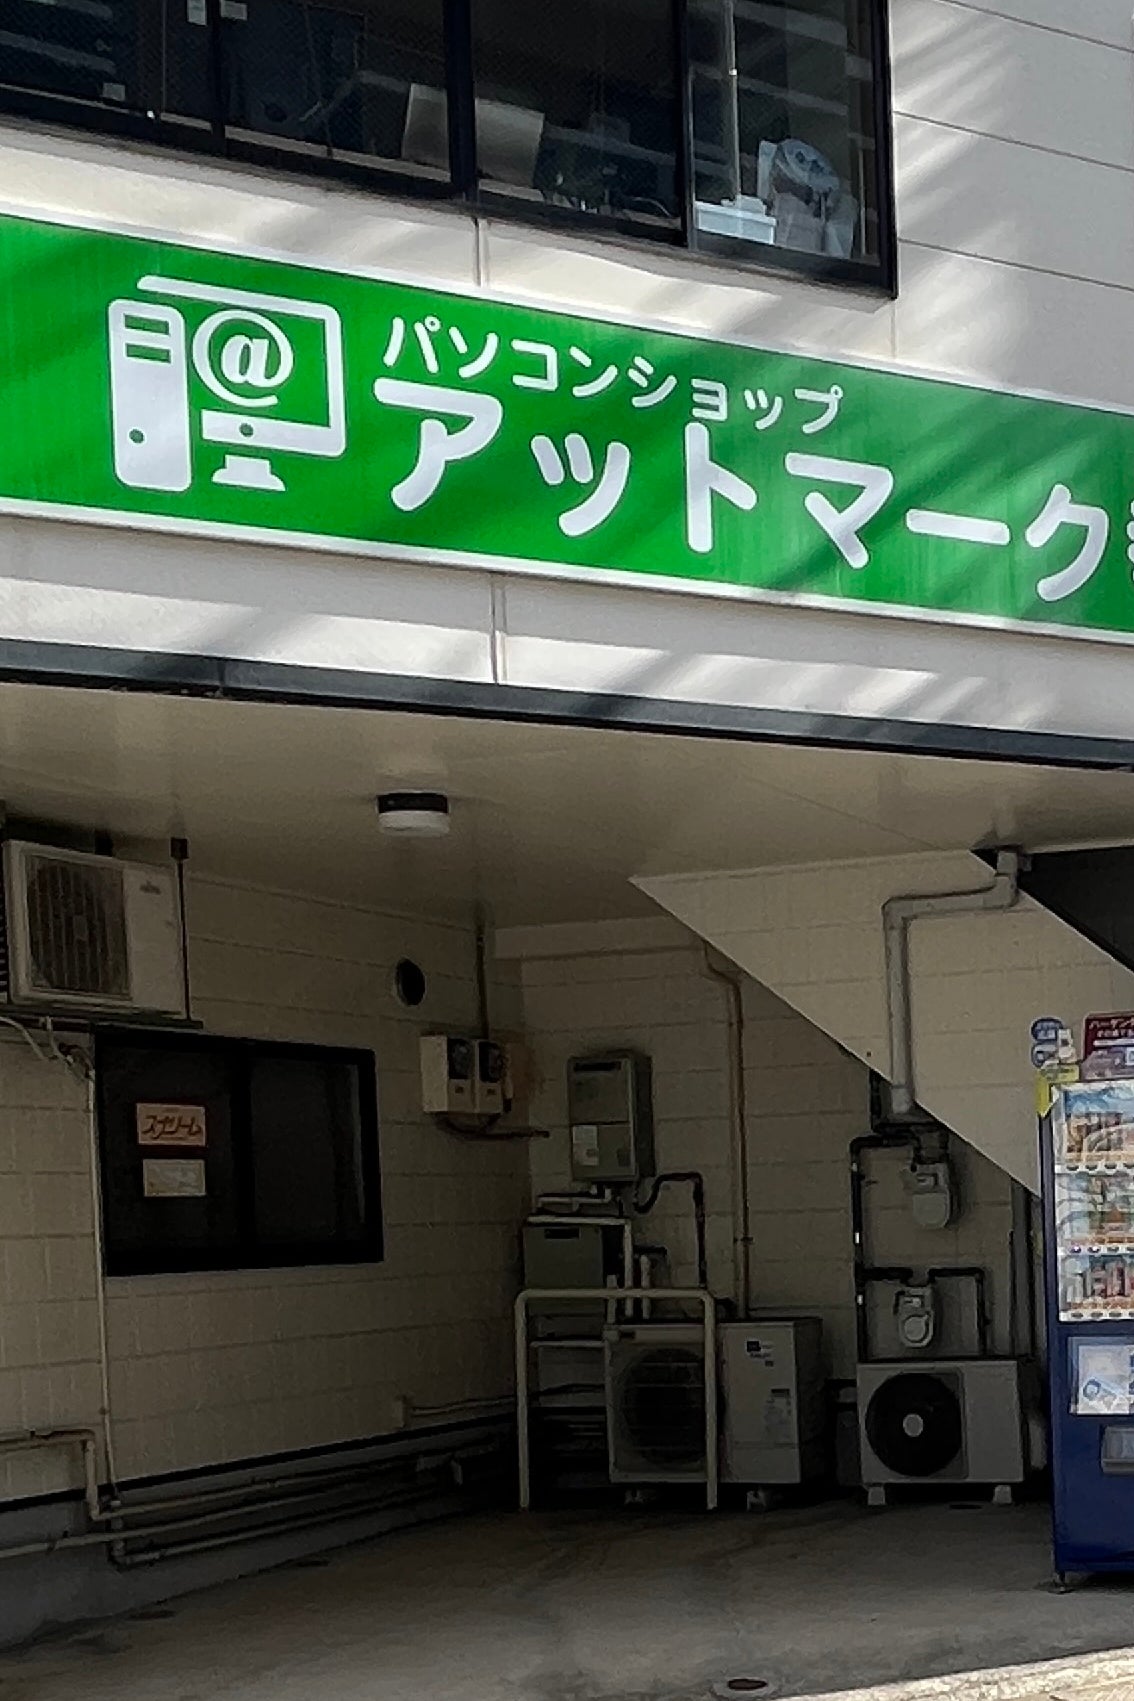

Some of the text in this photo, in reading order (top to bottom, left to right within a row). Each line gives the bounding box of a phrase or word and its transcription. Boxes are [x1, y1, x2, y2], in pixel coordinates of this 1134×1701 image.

[383, 315, 844, 435] パソコンショップ
[373, 376, 1110, 604] アットマーク
